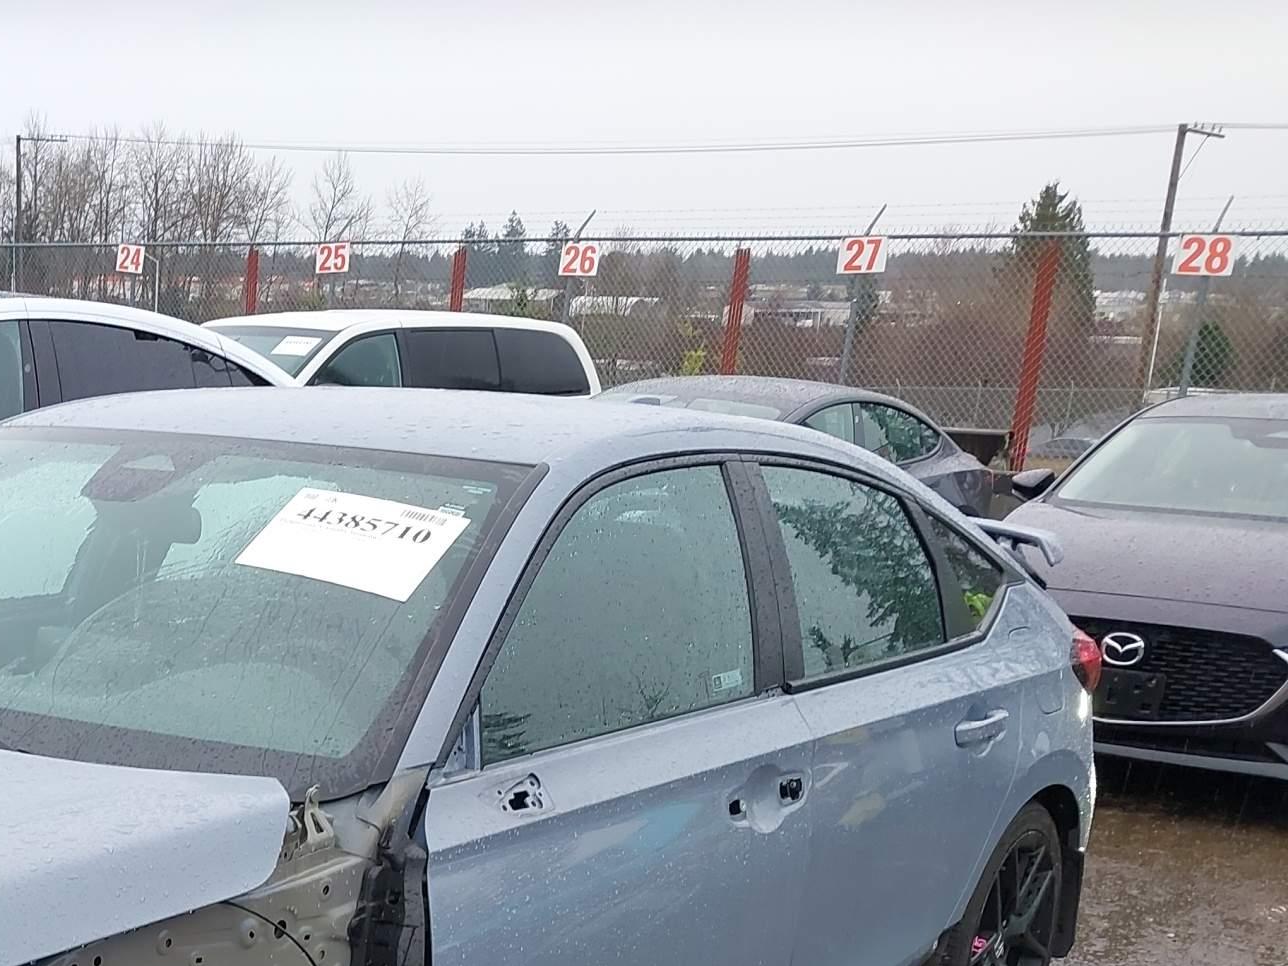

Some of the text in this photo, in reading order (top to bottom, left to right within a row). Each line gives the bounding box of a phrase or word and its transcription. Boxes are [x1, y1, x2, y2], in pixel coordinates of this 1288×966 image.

[119, 246, 142, 271] 24
[319, 245, 346, 271] 25
[562, 245, 597, 274] 26
[843, 239, 882, 271] 27
[1178, 237, 1232, 274] 28
[297, 507, 432, 544] 44385710
